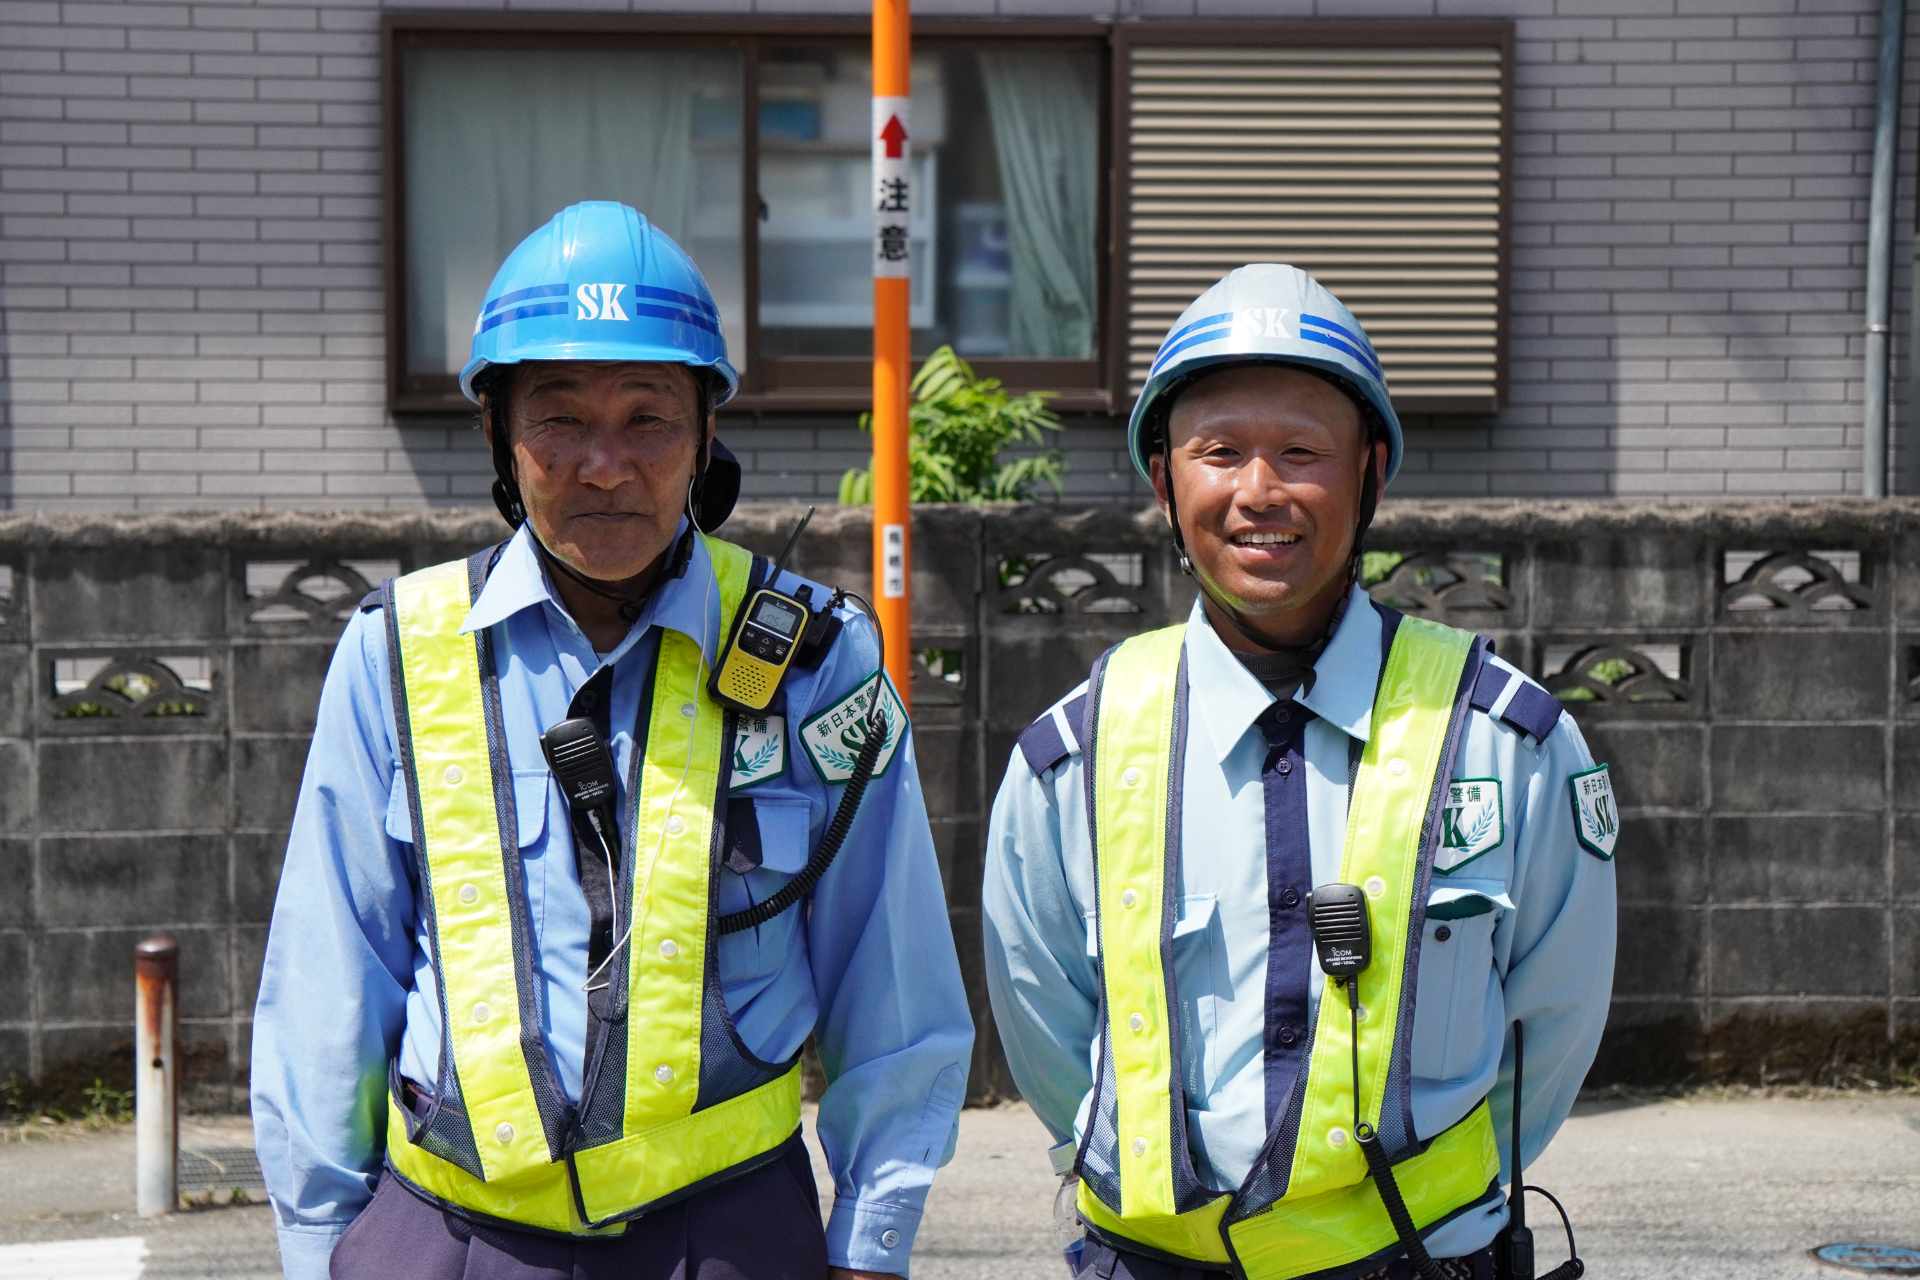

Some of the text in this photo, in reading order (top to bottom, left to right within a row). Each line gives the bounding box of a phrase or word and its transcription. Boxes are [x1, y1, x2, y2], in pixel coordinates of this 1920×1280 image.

[879, 177, 909, 261] 注意
[576, 283, 630, 321] SK
[1241, 307, 1293, 340] SK
[1449, 786, 1481, 804] 警備
[1437, 807, 1468, 849] K
[1595, 794, 1615, 838] SK
